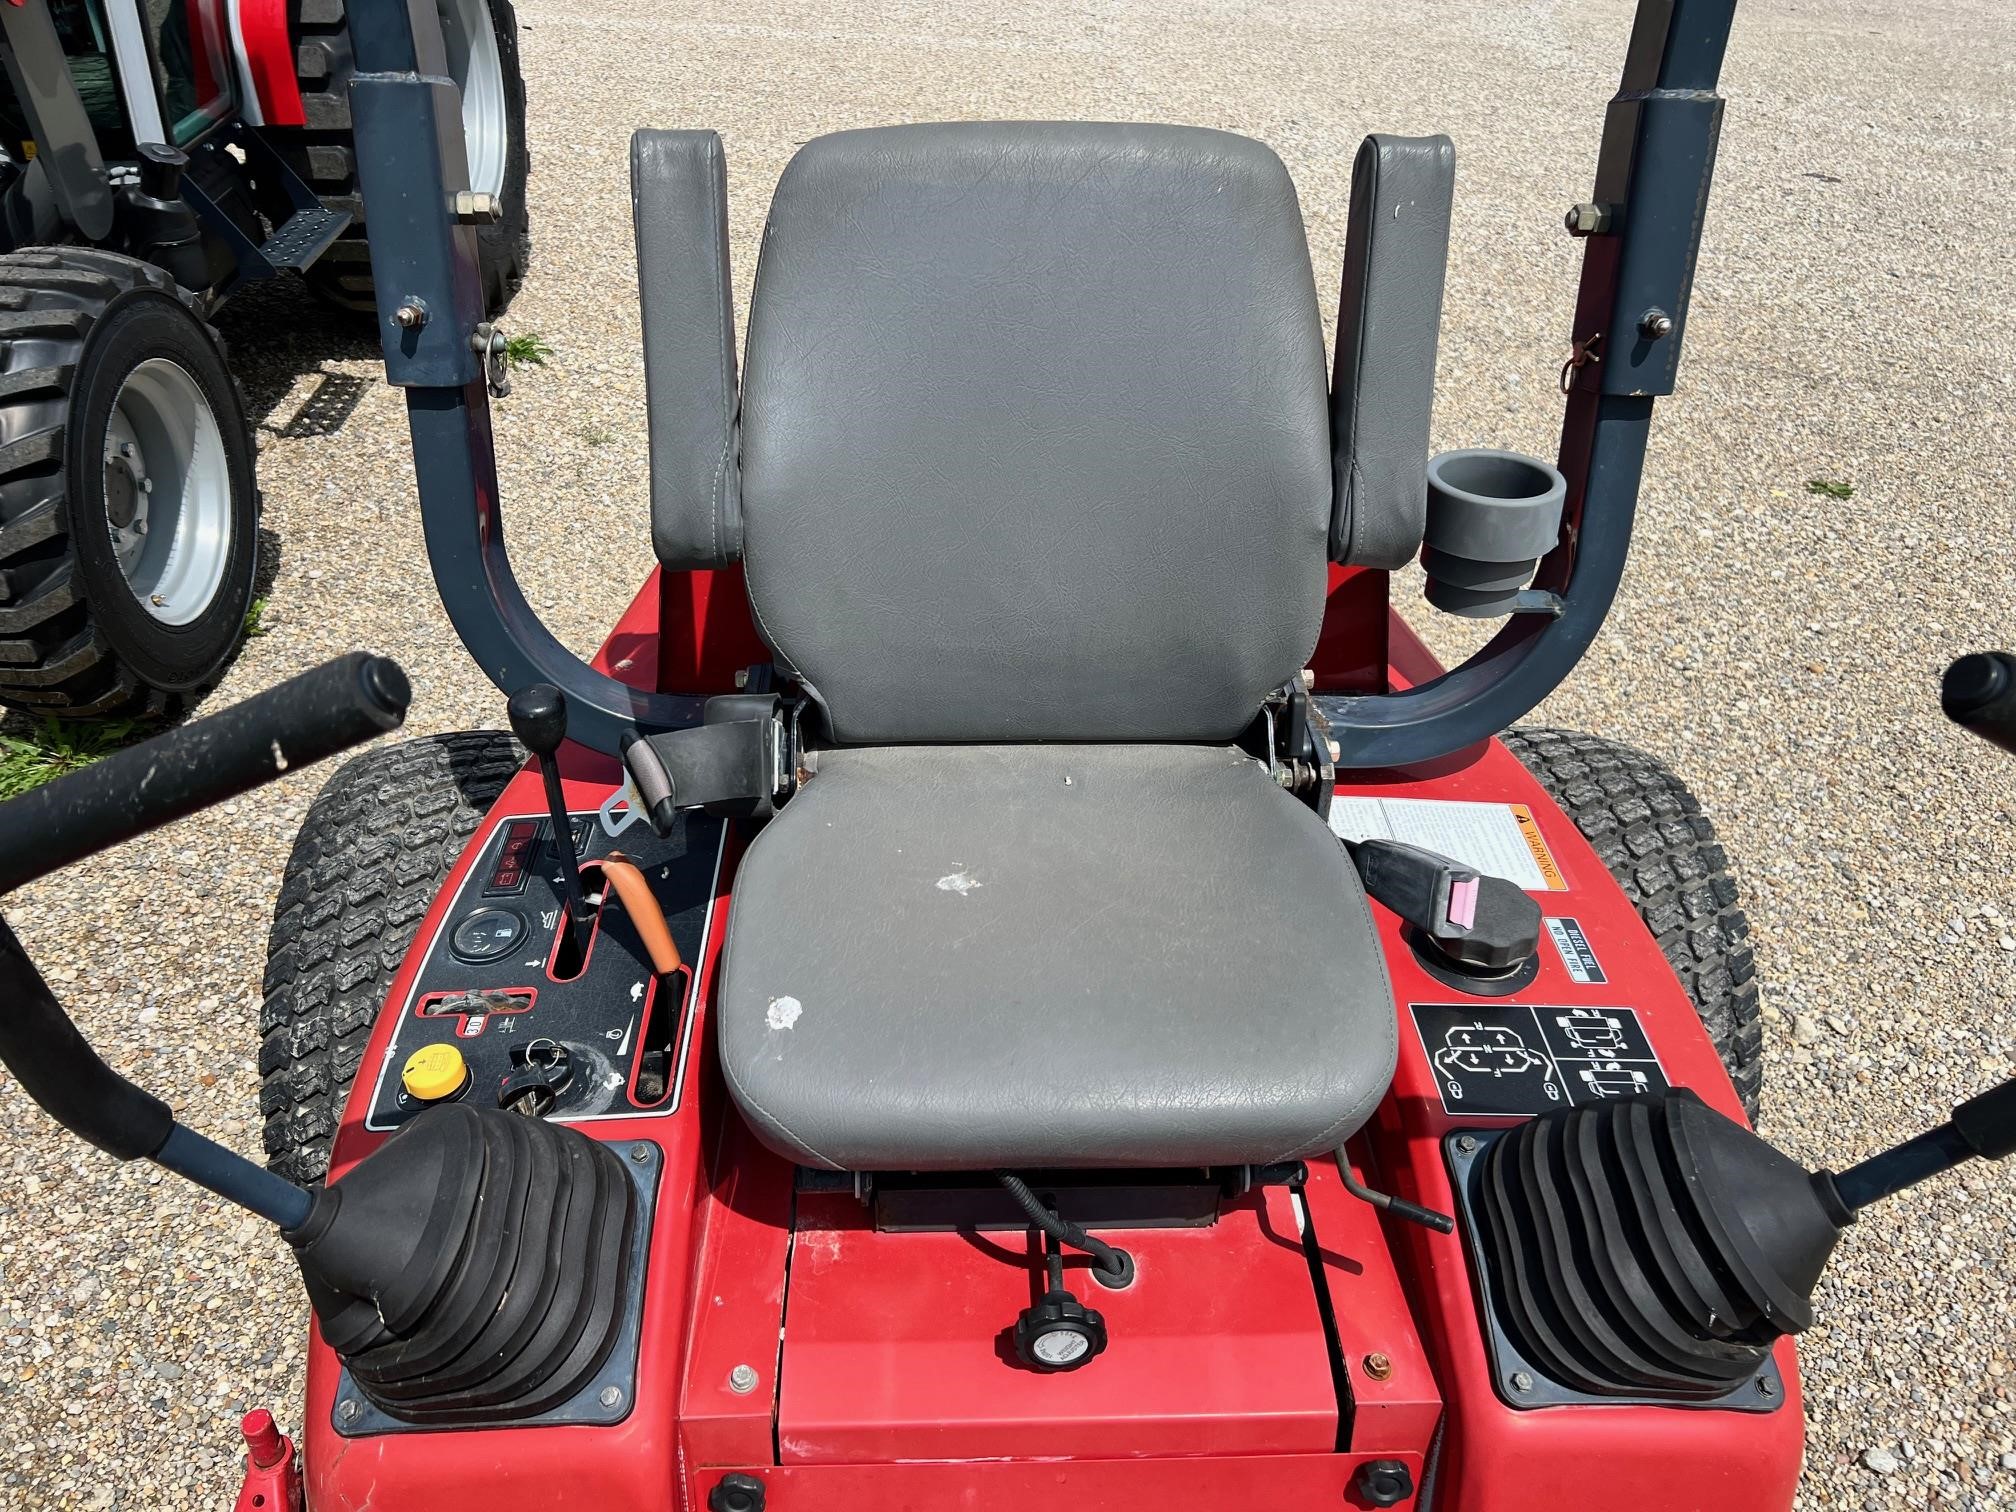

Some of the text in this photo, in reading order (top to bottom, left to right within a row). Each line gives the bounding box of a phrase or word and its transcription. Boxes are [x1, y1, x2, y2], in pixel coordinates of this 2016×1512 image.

[1525, 831, 1556, 878] WARNING
[1551, 926, 1582, 974] NO OPEN FIRE
[1567, 929, 1596, 970] DIESEL FUEL
[1474, 1021, 1484, 1031] R
[1482, 1044, 1492, 1053] N
[1493, 1068, 1502, 1077] F
